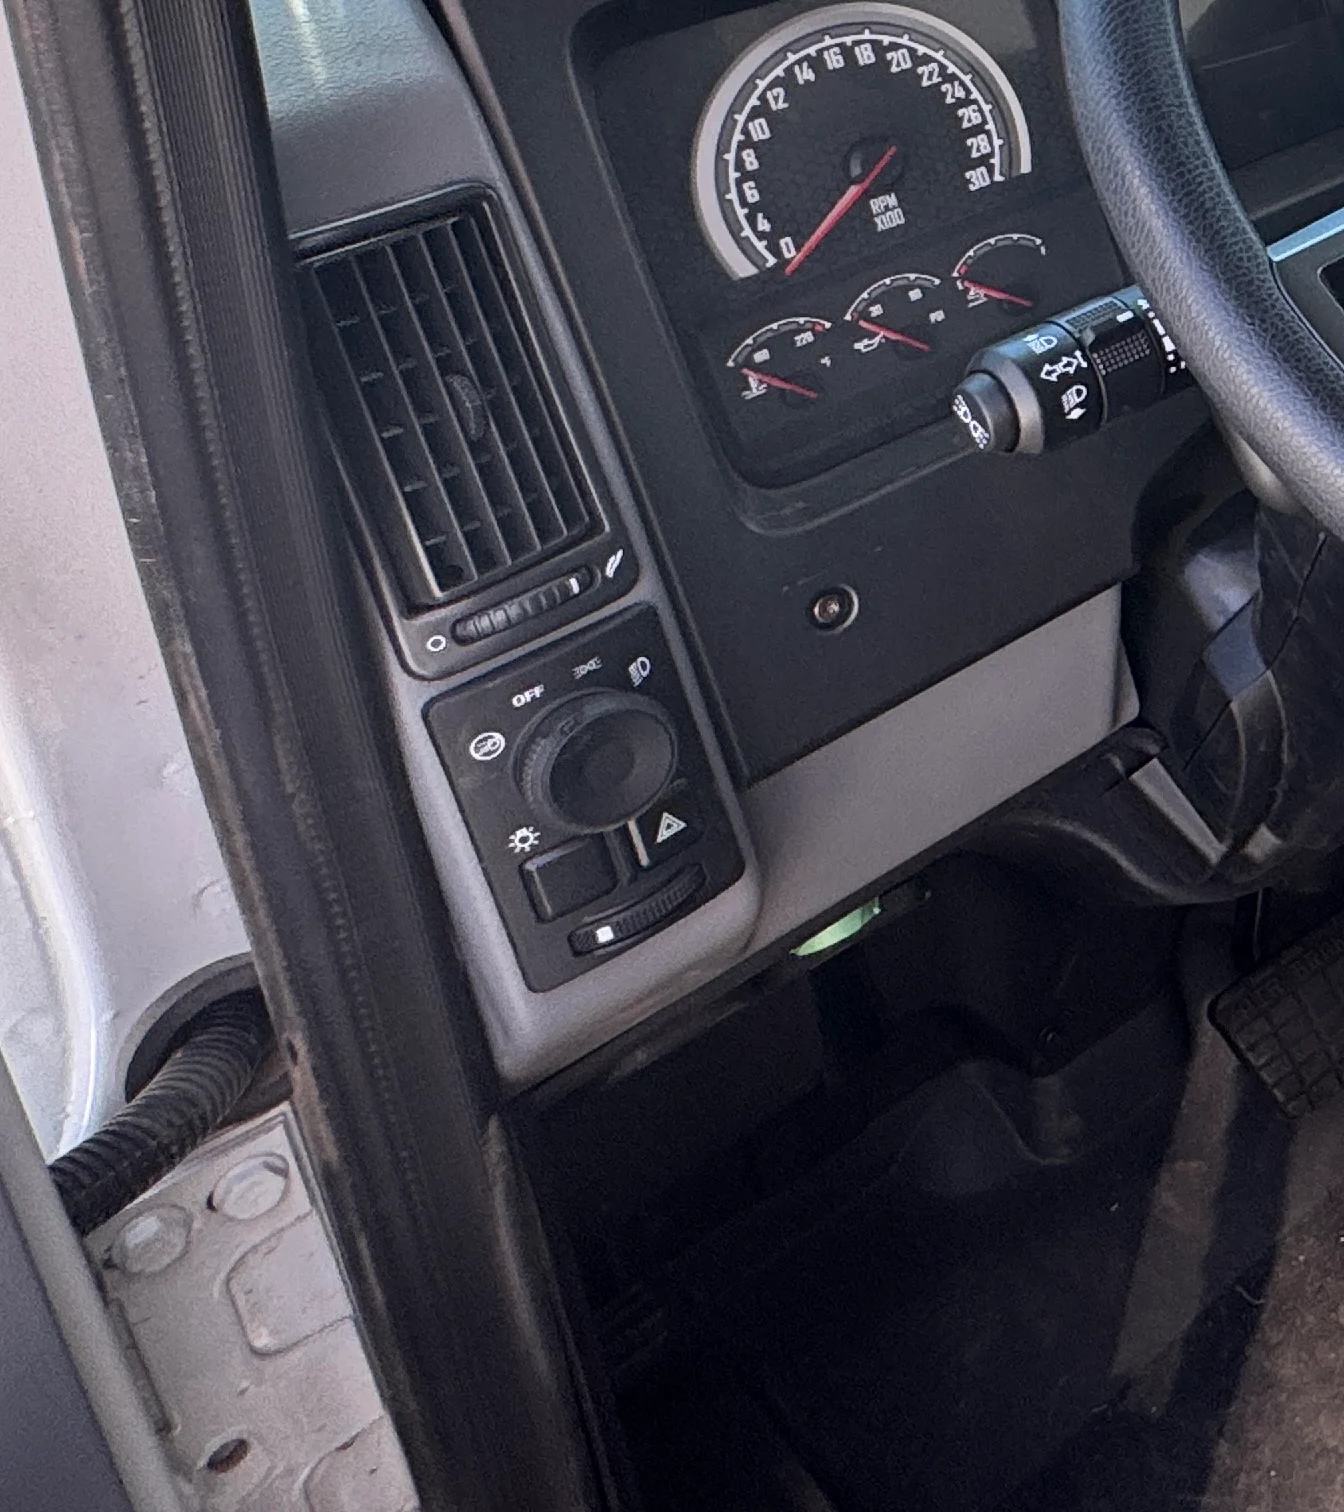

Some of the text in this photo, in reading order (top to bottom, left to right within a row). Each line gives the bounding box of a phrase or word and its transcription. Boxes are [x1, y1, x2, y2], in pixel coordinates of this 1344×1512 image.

[823, 47, 846, 71] 16
[854, 43, 876, 66] 18
[886, 48, 913, 74] 20
[794, 60, 816, 85] 14
[916, 62, 943, 88] 22
[766, 87, 790, 112] 12
[940, 80, 966, 104] 24
[957, 104, 982, 129] 26
[749, 118, 772, 141] 10
[967, 134, 992, 158] 28
[741, 148, 760, 171] 8
[965, 167, 991, 191] 30
[742, 181, 760, 204] 6
[869, 192, 899, 215] RPM
[757, 212, 772, 233] 4
[778, 237, 797, 259] 0
[511, 683, 545, 707] OFF
